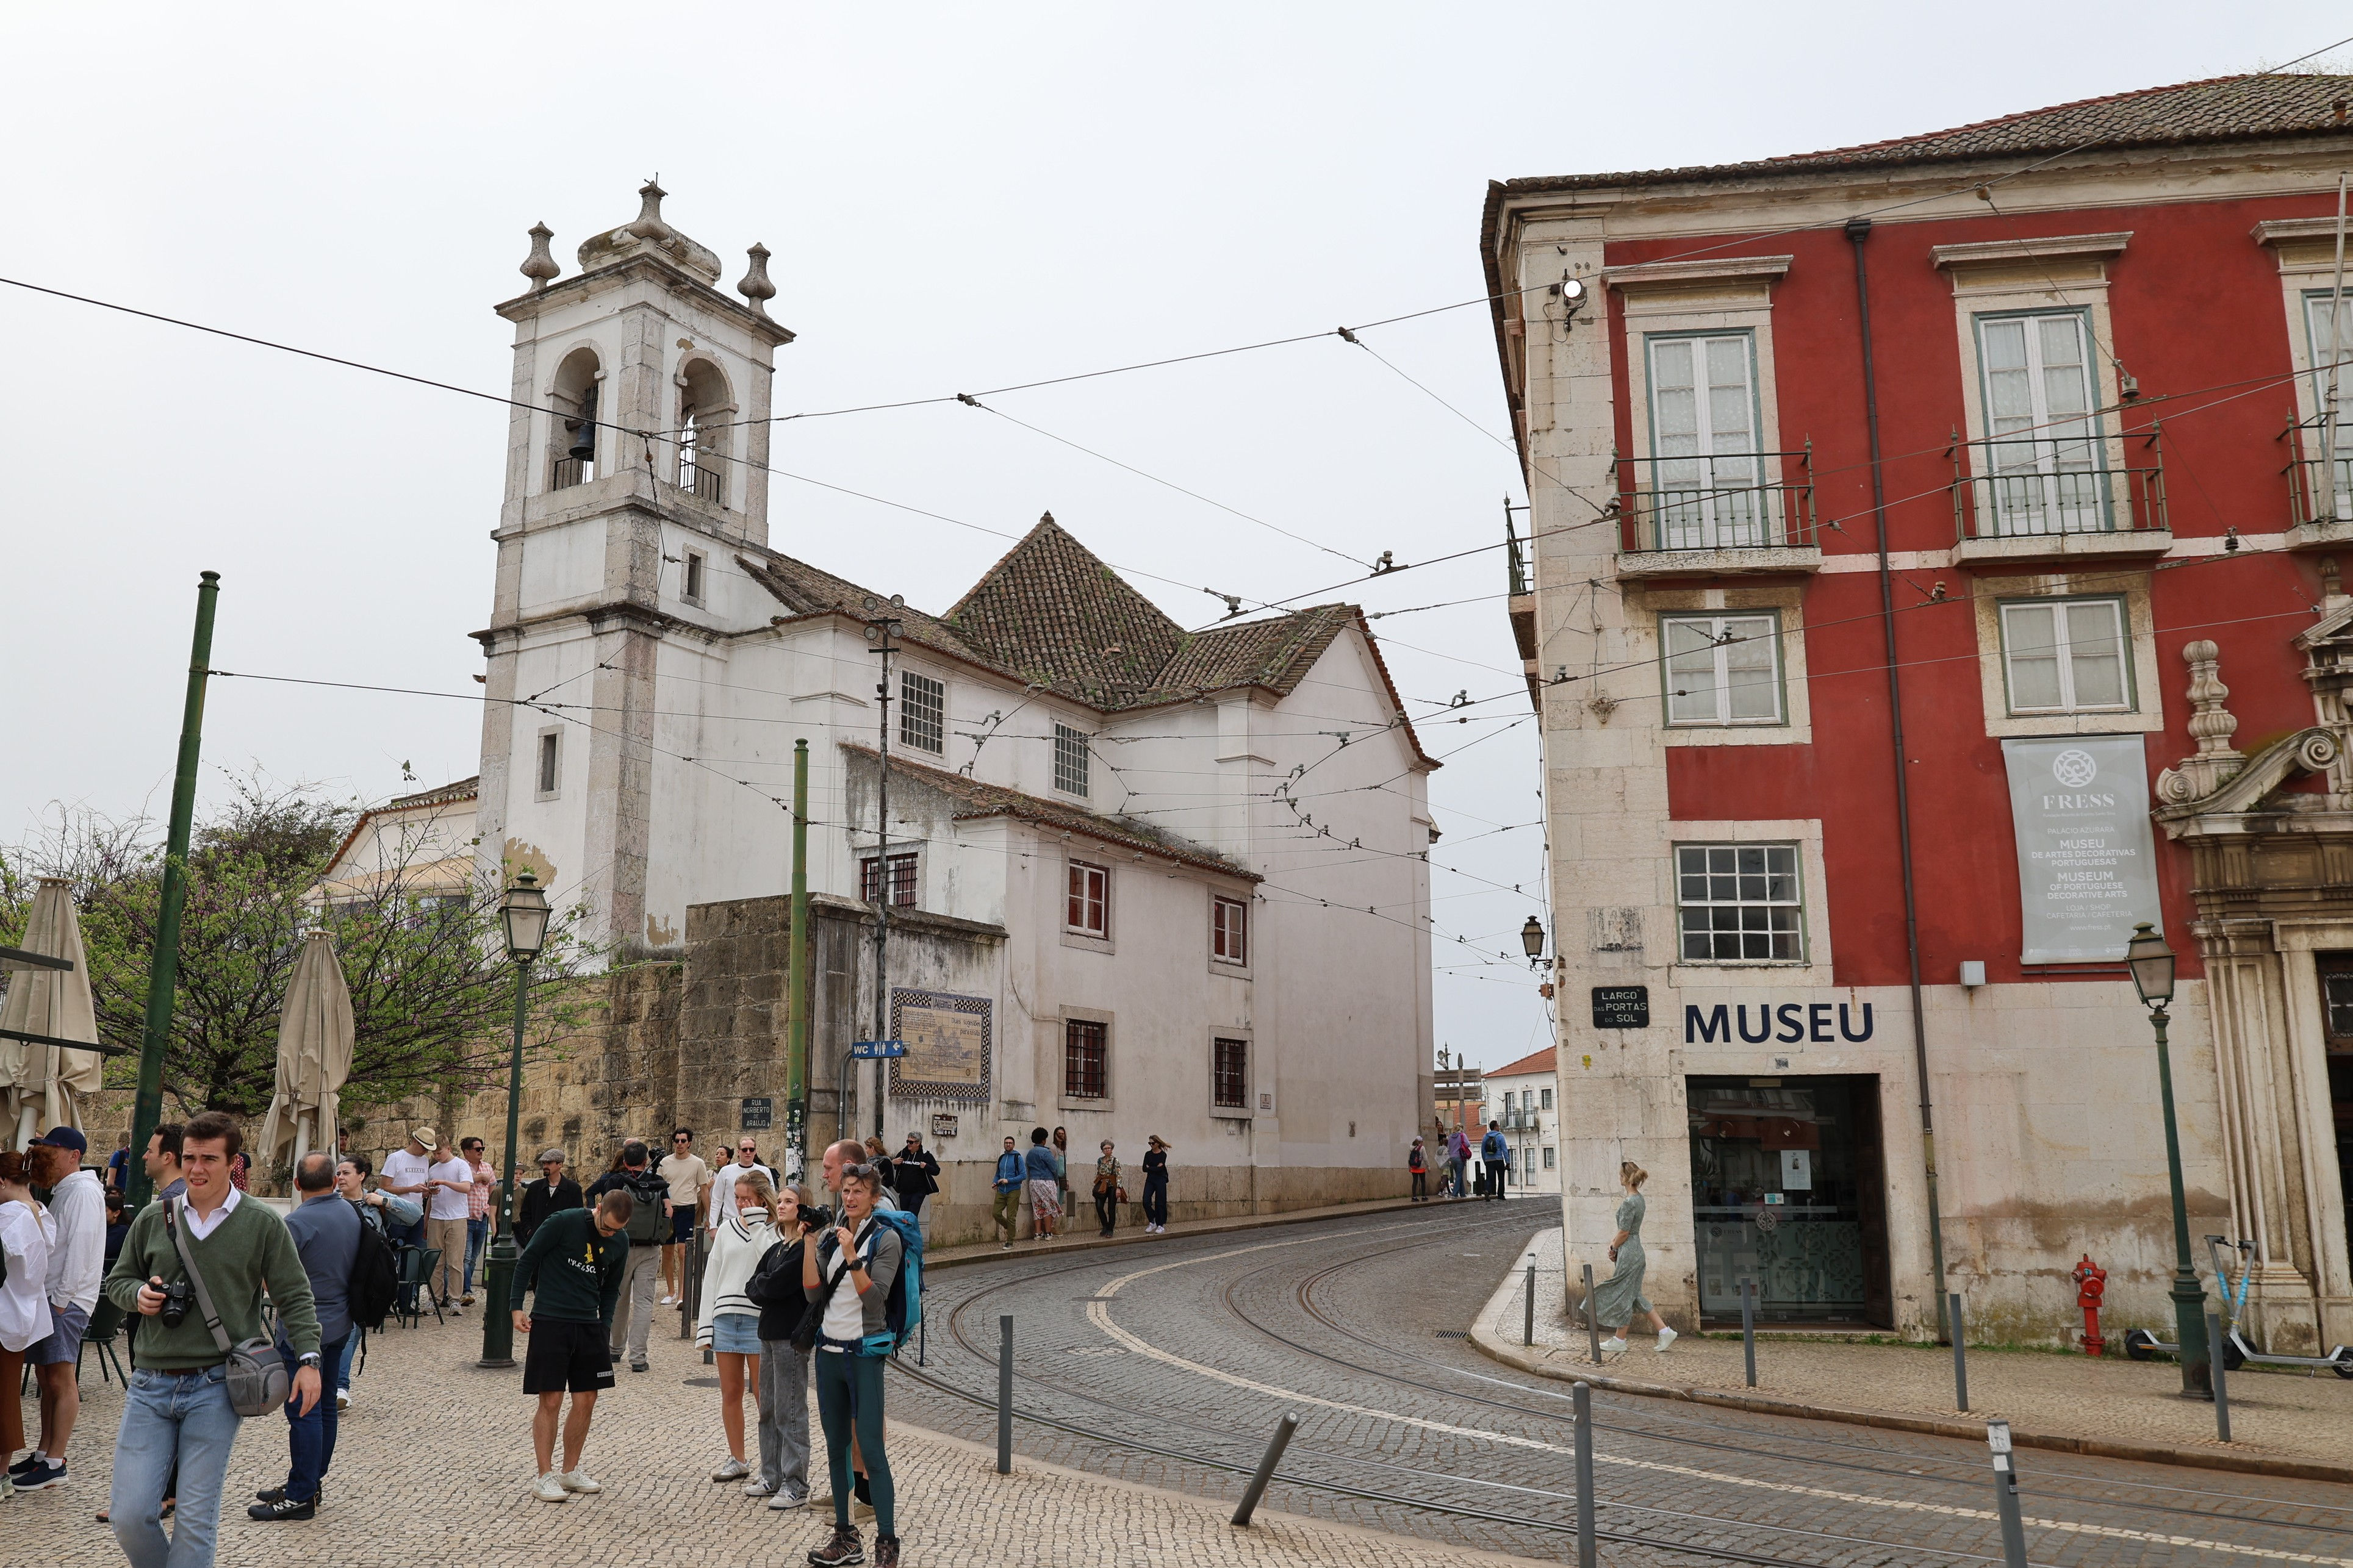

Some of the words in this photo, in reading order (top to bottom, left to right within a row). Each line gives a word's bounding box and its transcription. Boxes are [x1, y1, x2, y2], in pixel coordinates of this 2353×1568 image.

[2042, 793, 2115, 810] FRESS
[2060, 839, 2105, 849] MUSEU
[2075, 849, 2136, 857] DECORATIVAS
[2052, 858, 2117, 867] PORTUGUESAS
[2058, 871, 2113, 882] MUSEUM
[2064, 882, 2124, 890] PORTUGUESE
[934, 998, 952, 1010] Alfama
[1606, 1003, 1647, 1011] PORTAS
[1685, 1003, 1873, 1044] MUSEU
[854, 1045, 869, 1054] WC
